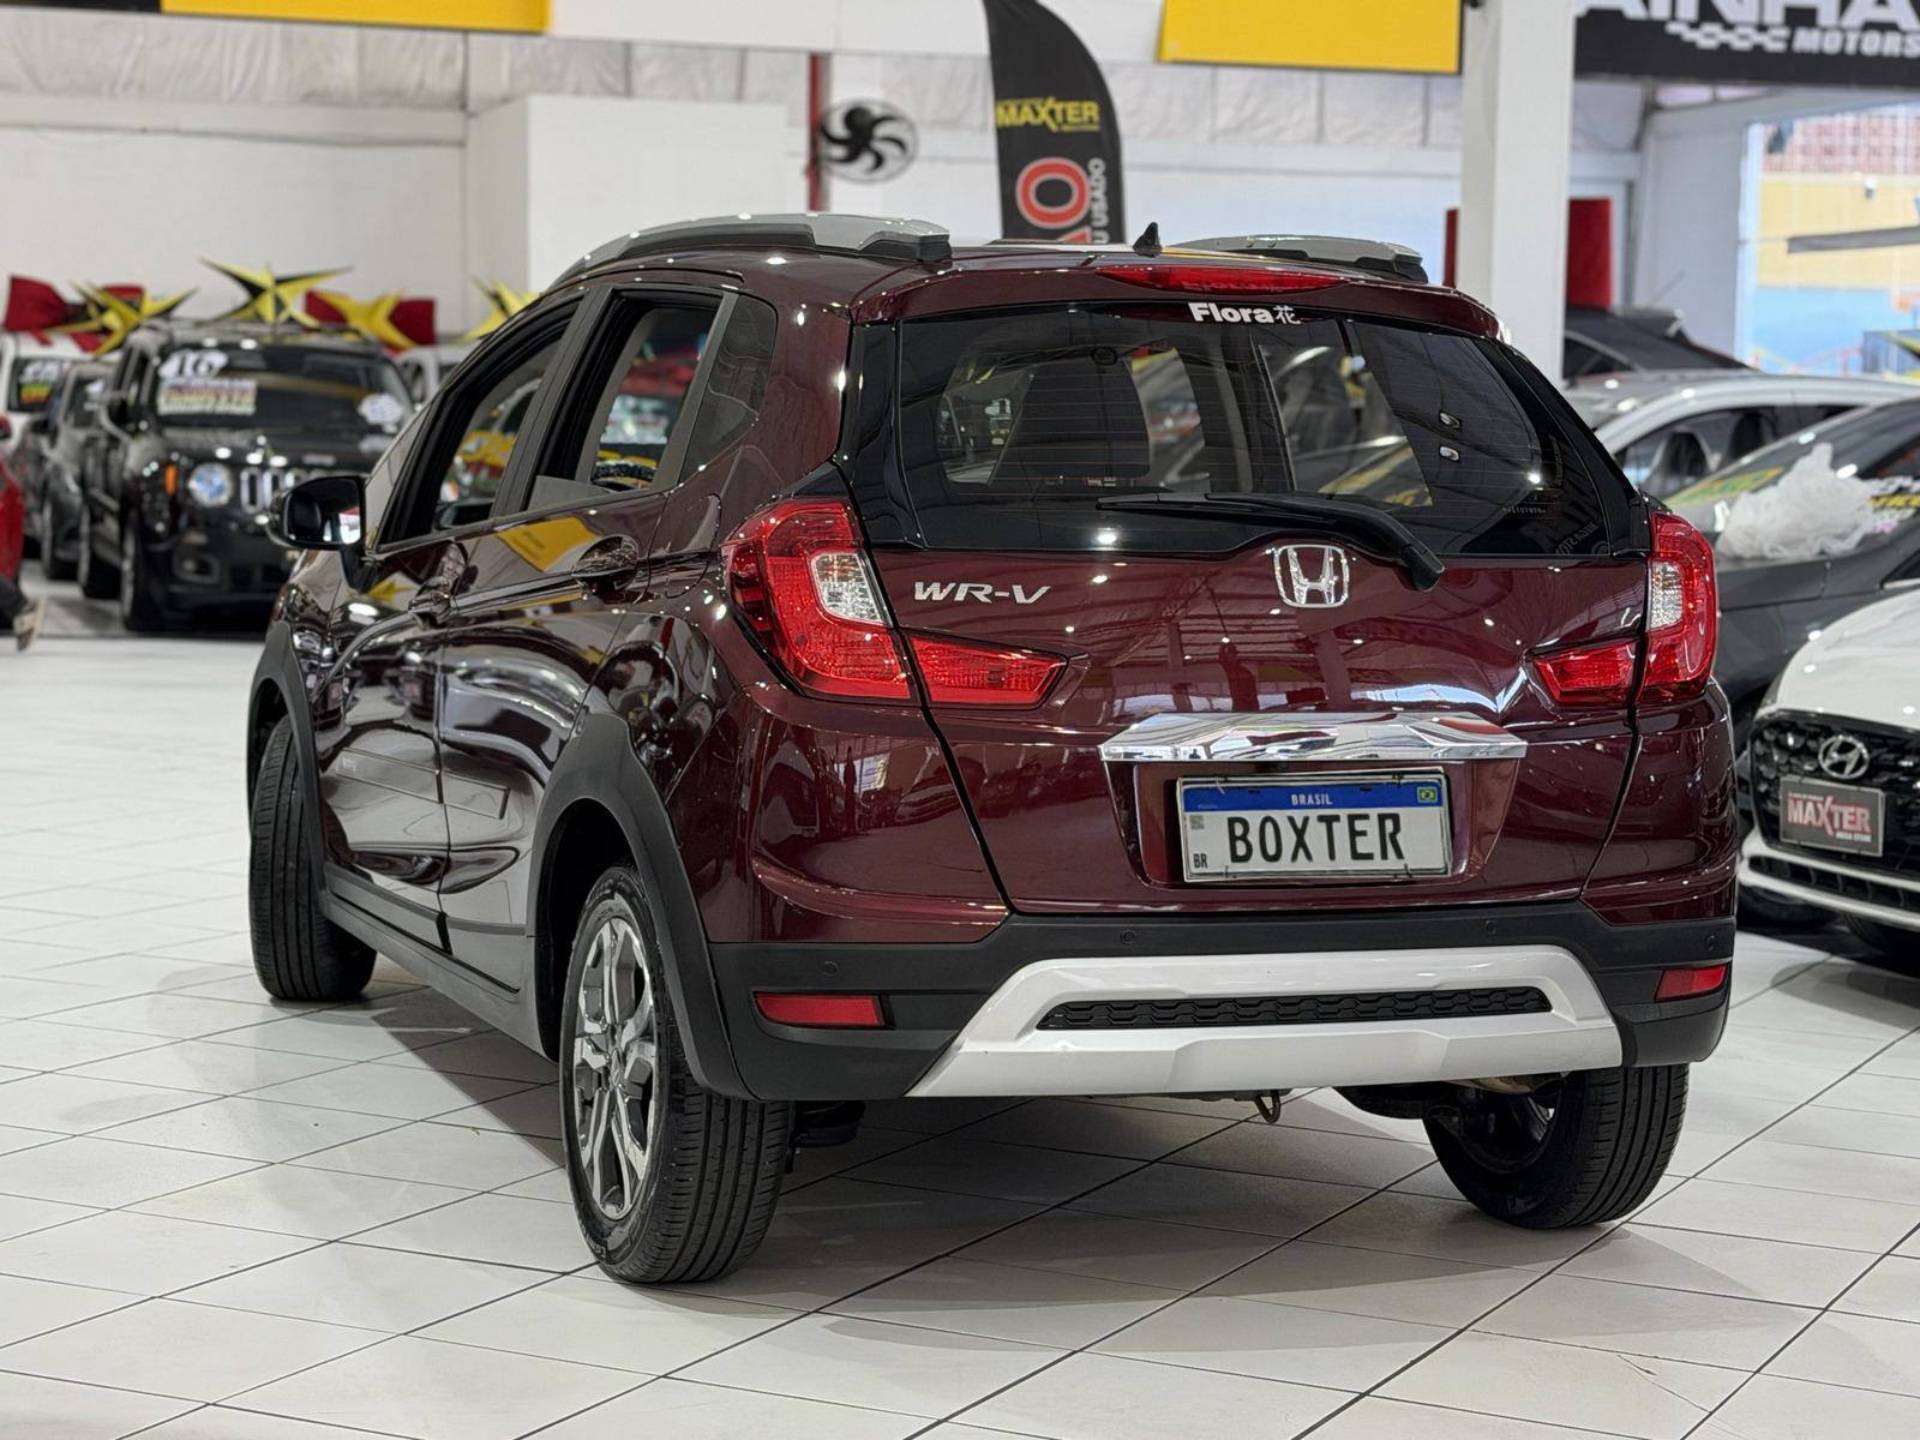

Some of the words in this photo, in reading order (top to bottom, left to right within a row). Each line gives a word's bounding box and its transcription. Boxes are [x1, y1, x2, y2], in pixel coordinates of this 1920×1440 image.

[1793, 27, 1920, 57] MOTORS
[996, 97, 1100, 132] MAXTER
[1188, 302, 1275, 323] Flora
[914, 581, 1051, 604] WR-V
[1291, 793, 1334, 806] BRASIL
[1787, 795, 1872, 836] MAXTER
[1227, 813, 1405, 863] BOXTER
[1193, 853, 1208, 868] BR
